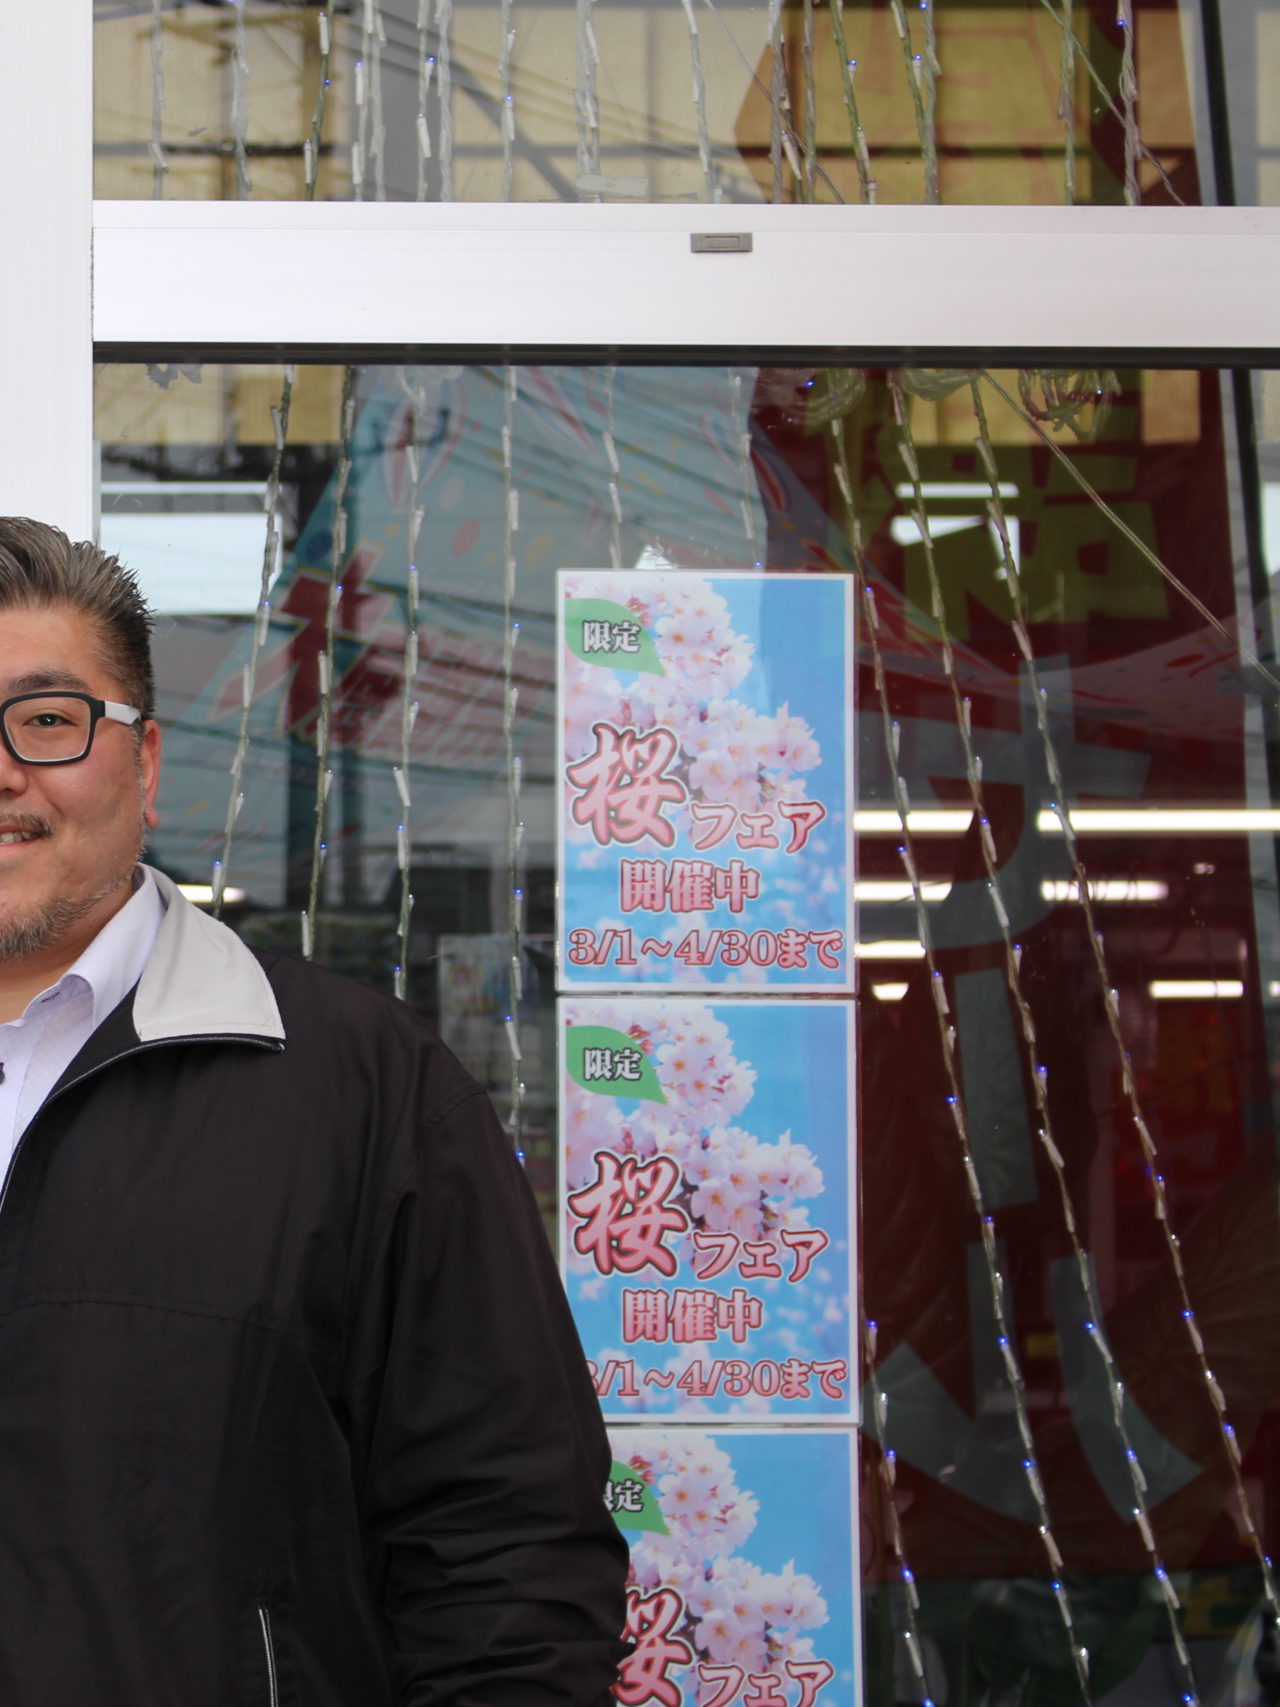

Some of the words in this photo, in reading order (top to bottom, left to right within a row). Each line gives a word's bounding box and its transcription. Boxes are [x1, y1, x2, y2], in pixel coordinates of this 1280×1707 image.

[581, 620, 642, 654] 限定
[566, 721, 827, 854] 桜フェア
[620, 858, 760, 914] 開催中
[583, 1047, 644, 1082] 限定
[567, 1151, 829, 1283] 桜フェア
[622, 1288, 763, 1344] 開催中
